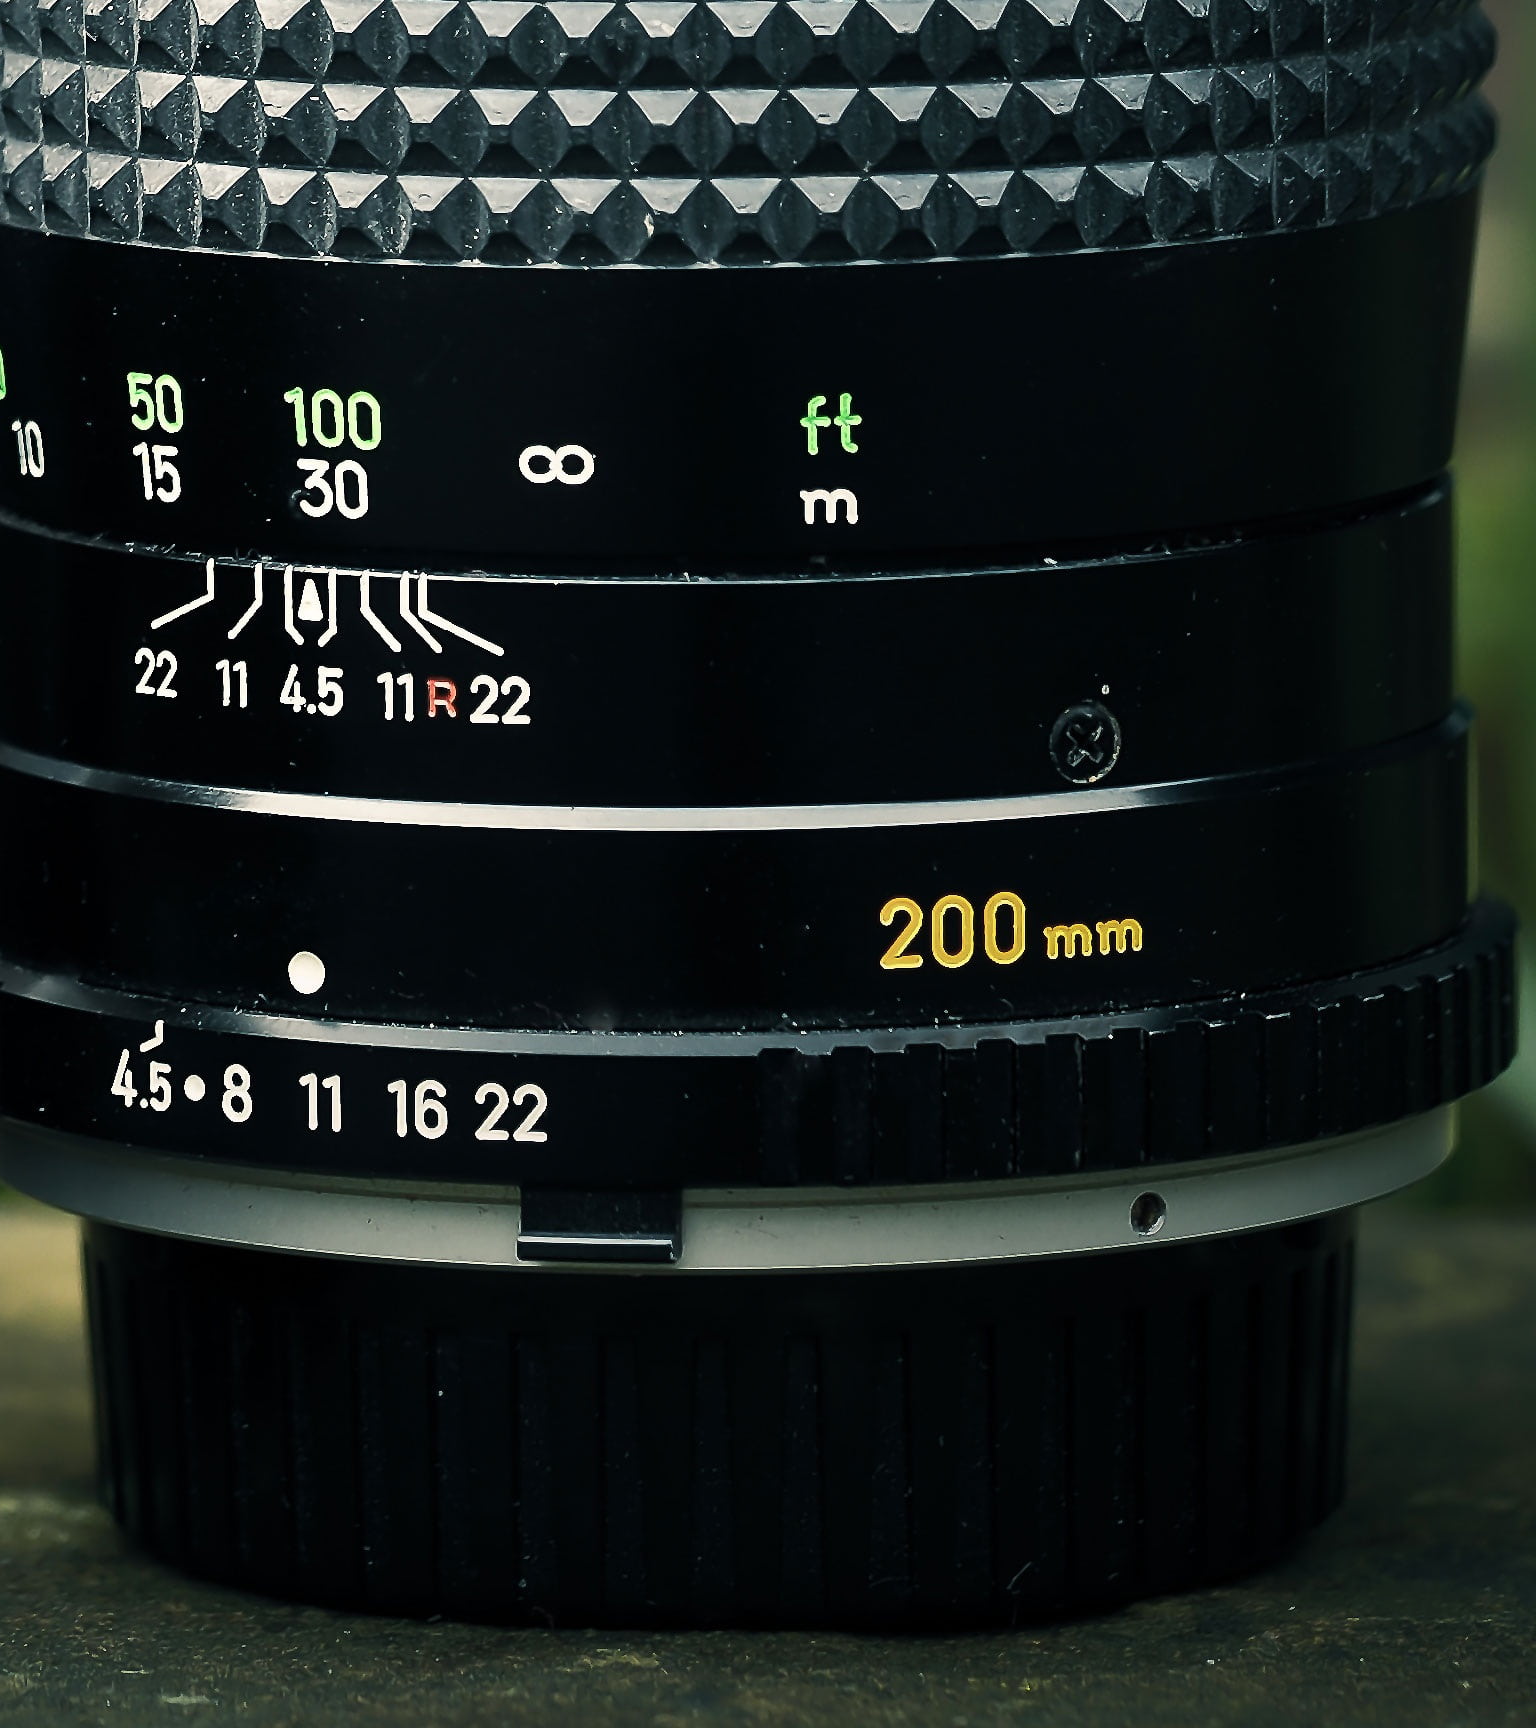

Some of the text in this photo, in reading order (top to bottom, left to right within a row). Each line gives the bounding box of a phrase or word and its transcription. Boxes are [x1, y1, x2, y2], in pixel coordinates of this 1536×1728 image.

[127, 373, 184, 435] 50
[284, 386, 382, 451] 100
[800, 392, 862, 455] ft
[11, 418, 45, 478] 10
[131, 443, 182, 503] 15
[295, 457, 370, 520] 30
[799, 487, 859, 525] m
[134, 648, 531, 725] 22 11 4.5 11 R 22
[878, 890, 1144, 970] 200 mm
[110, 1048, 549, 1143] 4.5 8 11 16 22
